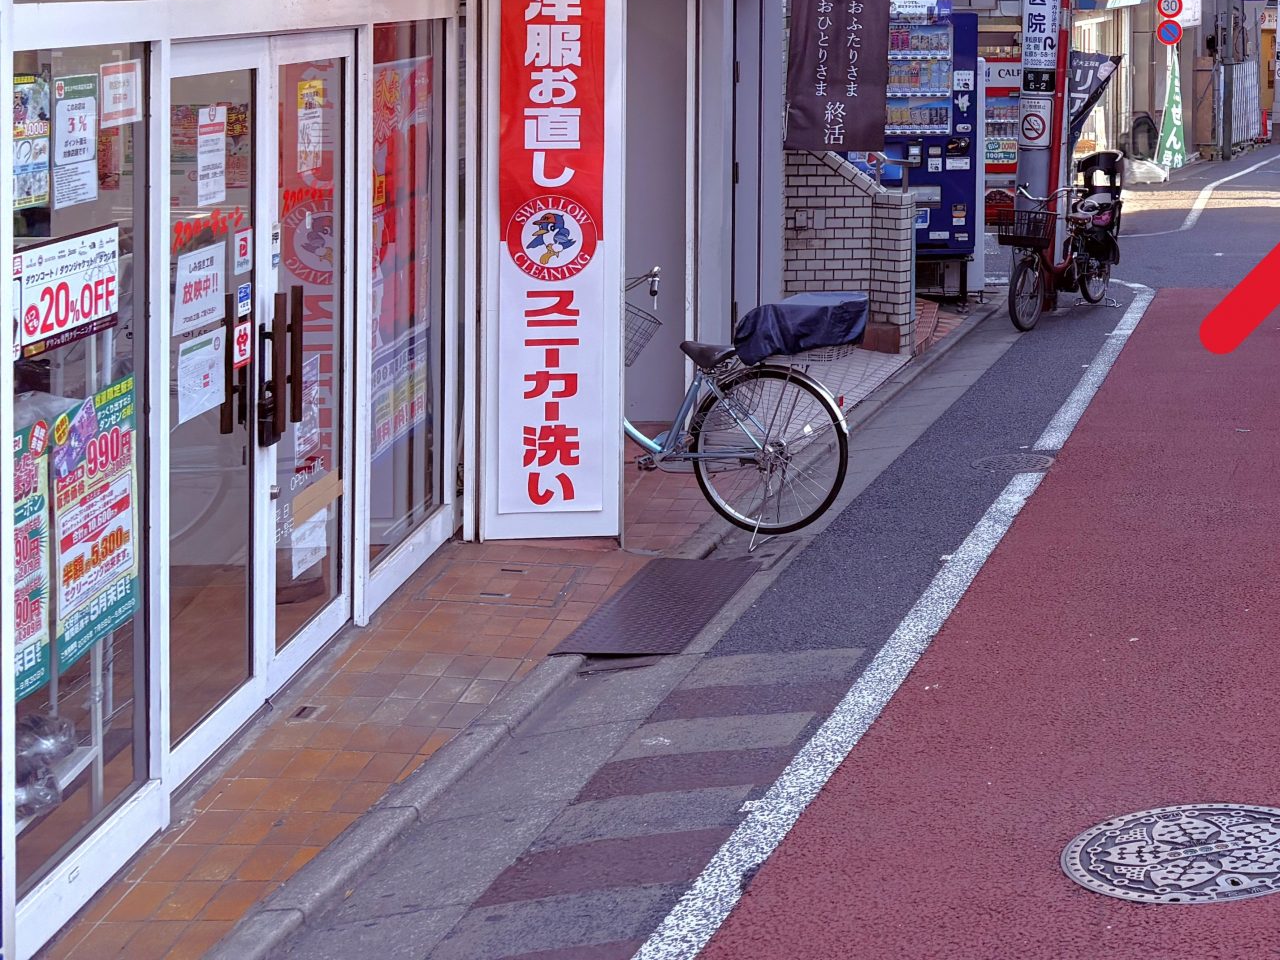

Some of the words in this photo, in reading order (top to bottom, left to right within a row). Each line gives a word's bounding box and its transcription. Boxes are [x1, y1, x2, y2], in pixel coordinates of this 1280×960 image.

[1162, 0, 1177, 12] 30
[814, 0, 834, 97] おひとりさま
[846, 0, 864, 97] おふたりさま
[1029, 82, 1047, 90] 5-2
[823, 101, 847, 145] 終活
[514, 196, 591, 226] SWALLOW
[513, 251, 591, 281] CLEANING
[522, 290, 580, 505] スニーカー洗い
